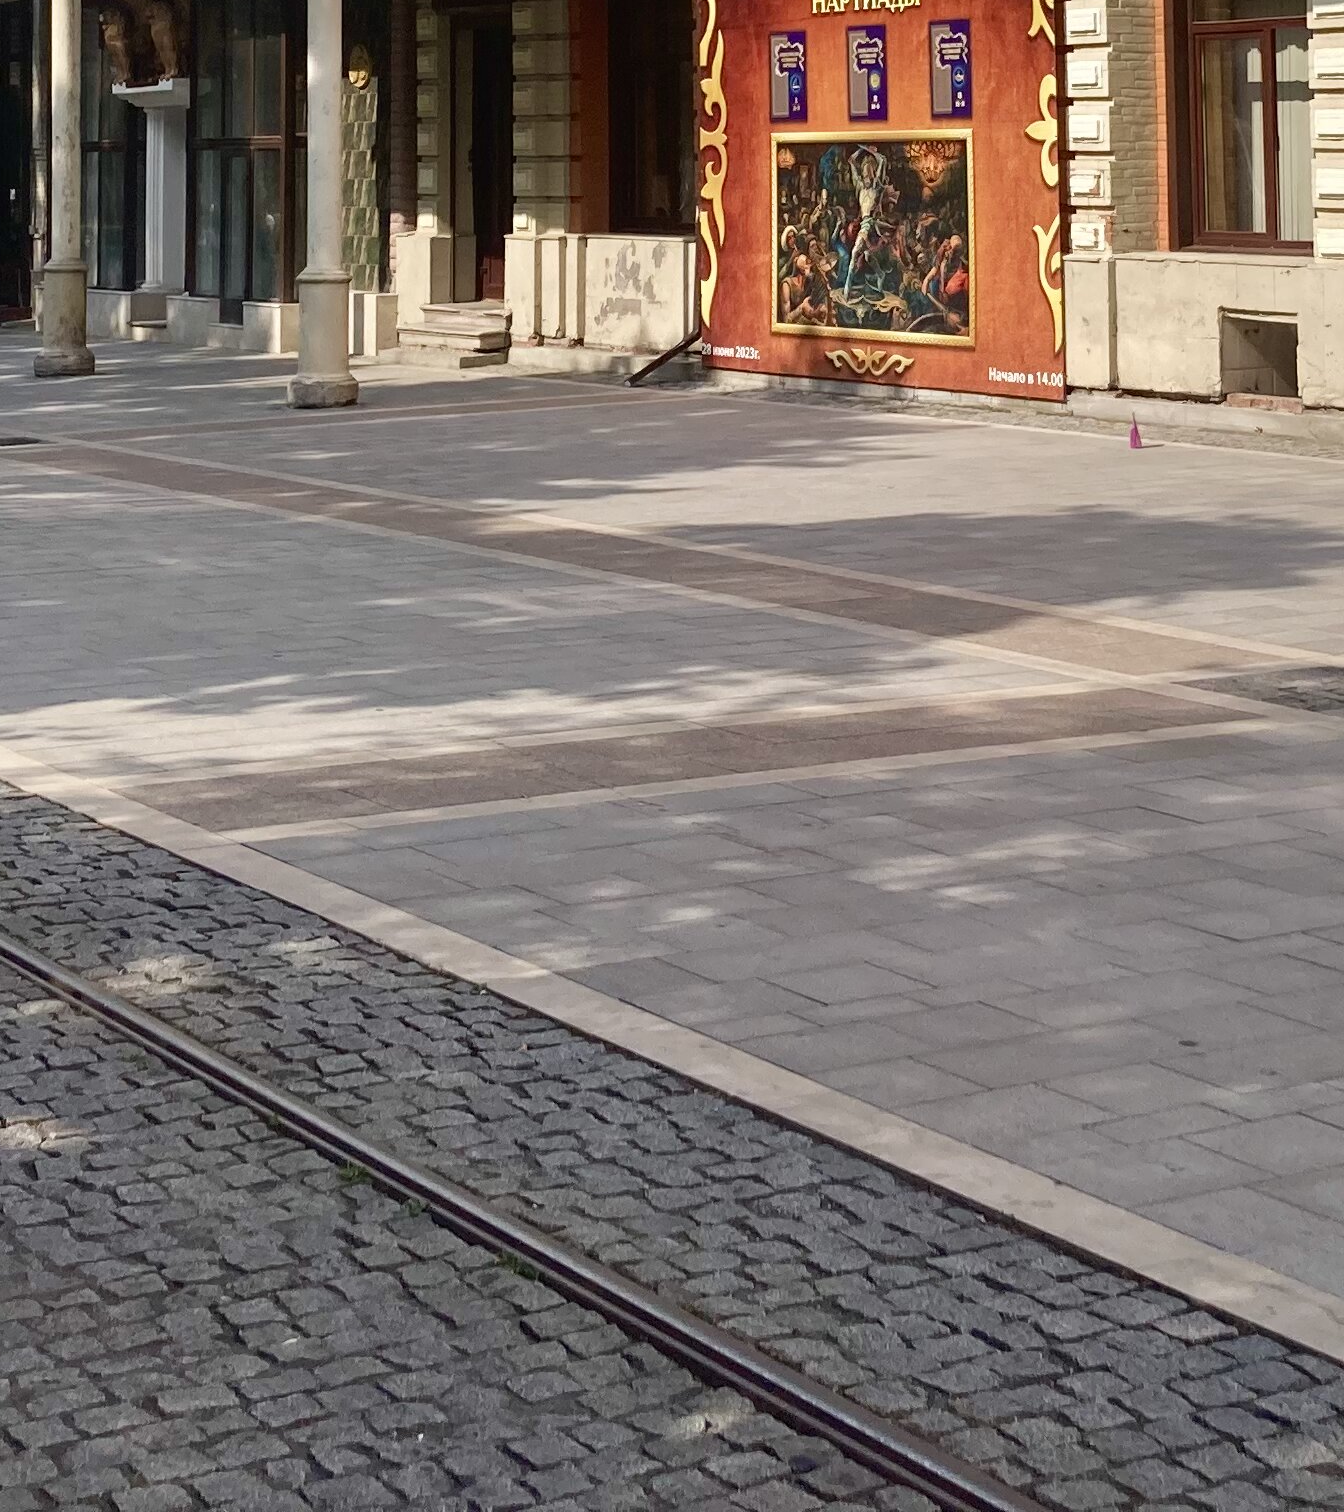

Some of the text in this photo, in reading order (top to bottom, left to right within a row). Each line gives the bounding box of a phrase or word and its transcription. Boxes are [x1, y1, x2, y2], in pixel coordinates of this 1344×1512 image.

[713, 346, 734, 357] июня
[735, 345, 761, 359] 2023г.
[988, 367, 1064, 387] Начало в 14.00
